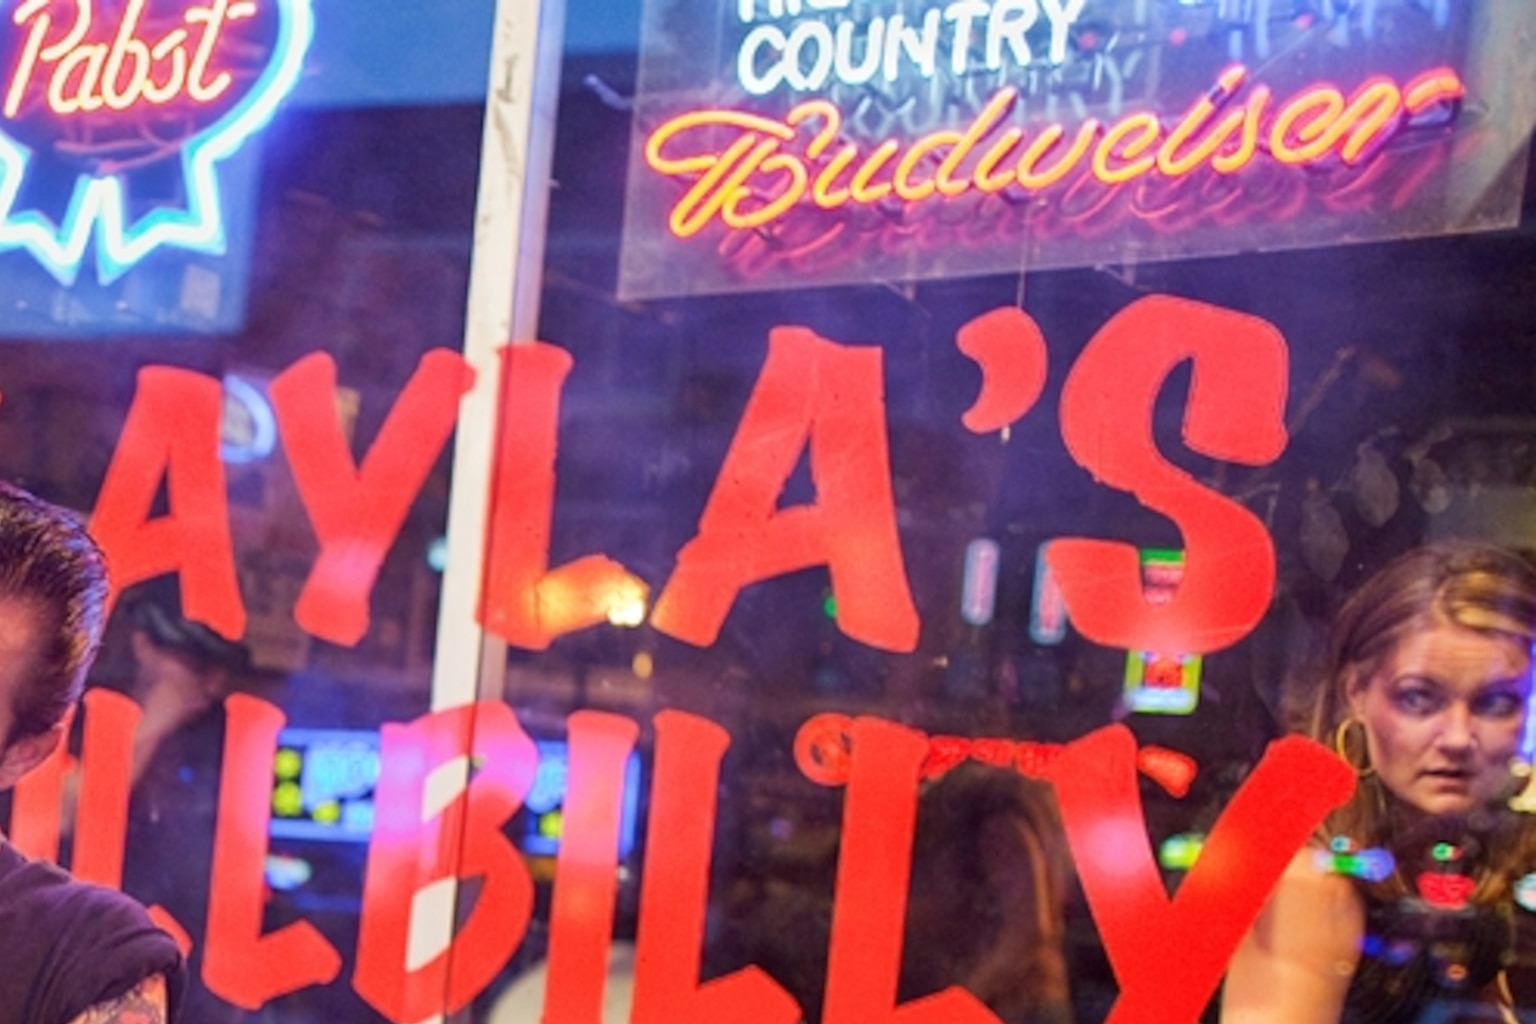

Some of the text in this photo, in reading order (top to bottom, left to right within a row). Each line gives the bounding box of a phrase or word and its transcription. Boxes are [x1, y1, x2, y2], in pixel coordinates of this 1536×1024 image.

[4, 0, 257, 118] Pabst
[737, 0, 1088, 95] COUNTRY
[642, 62, 1464, 240] Budweiser
